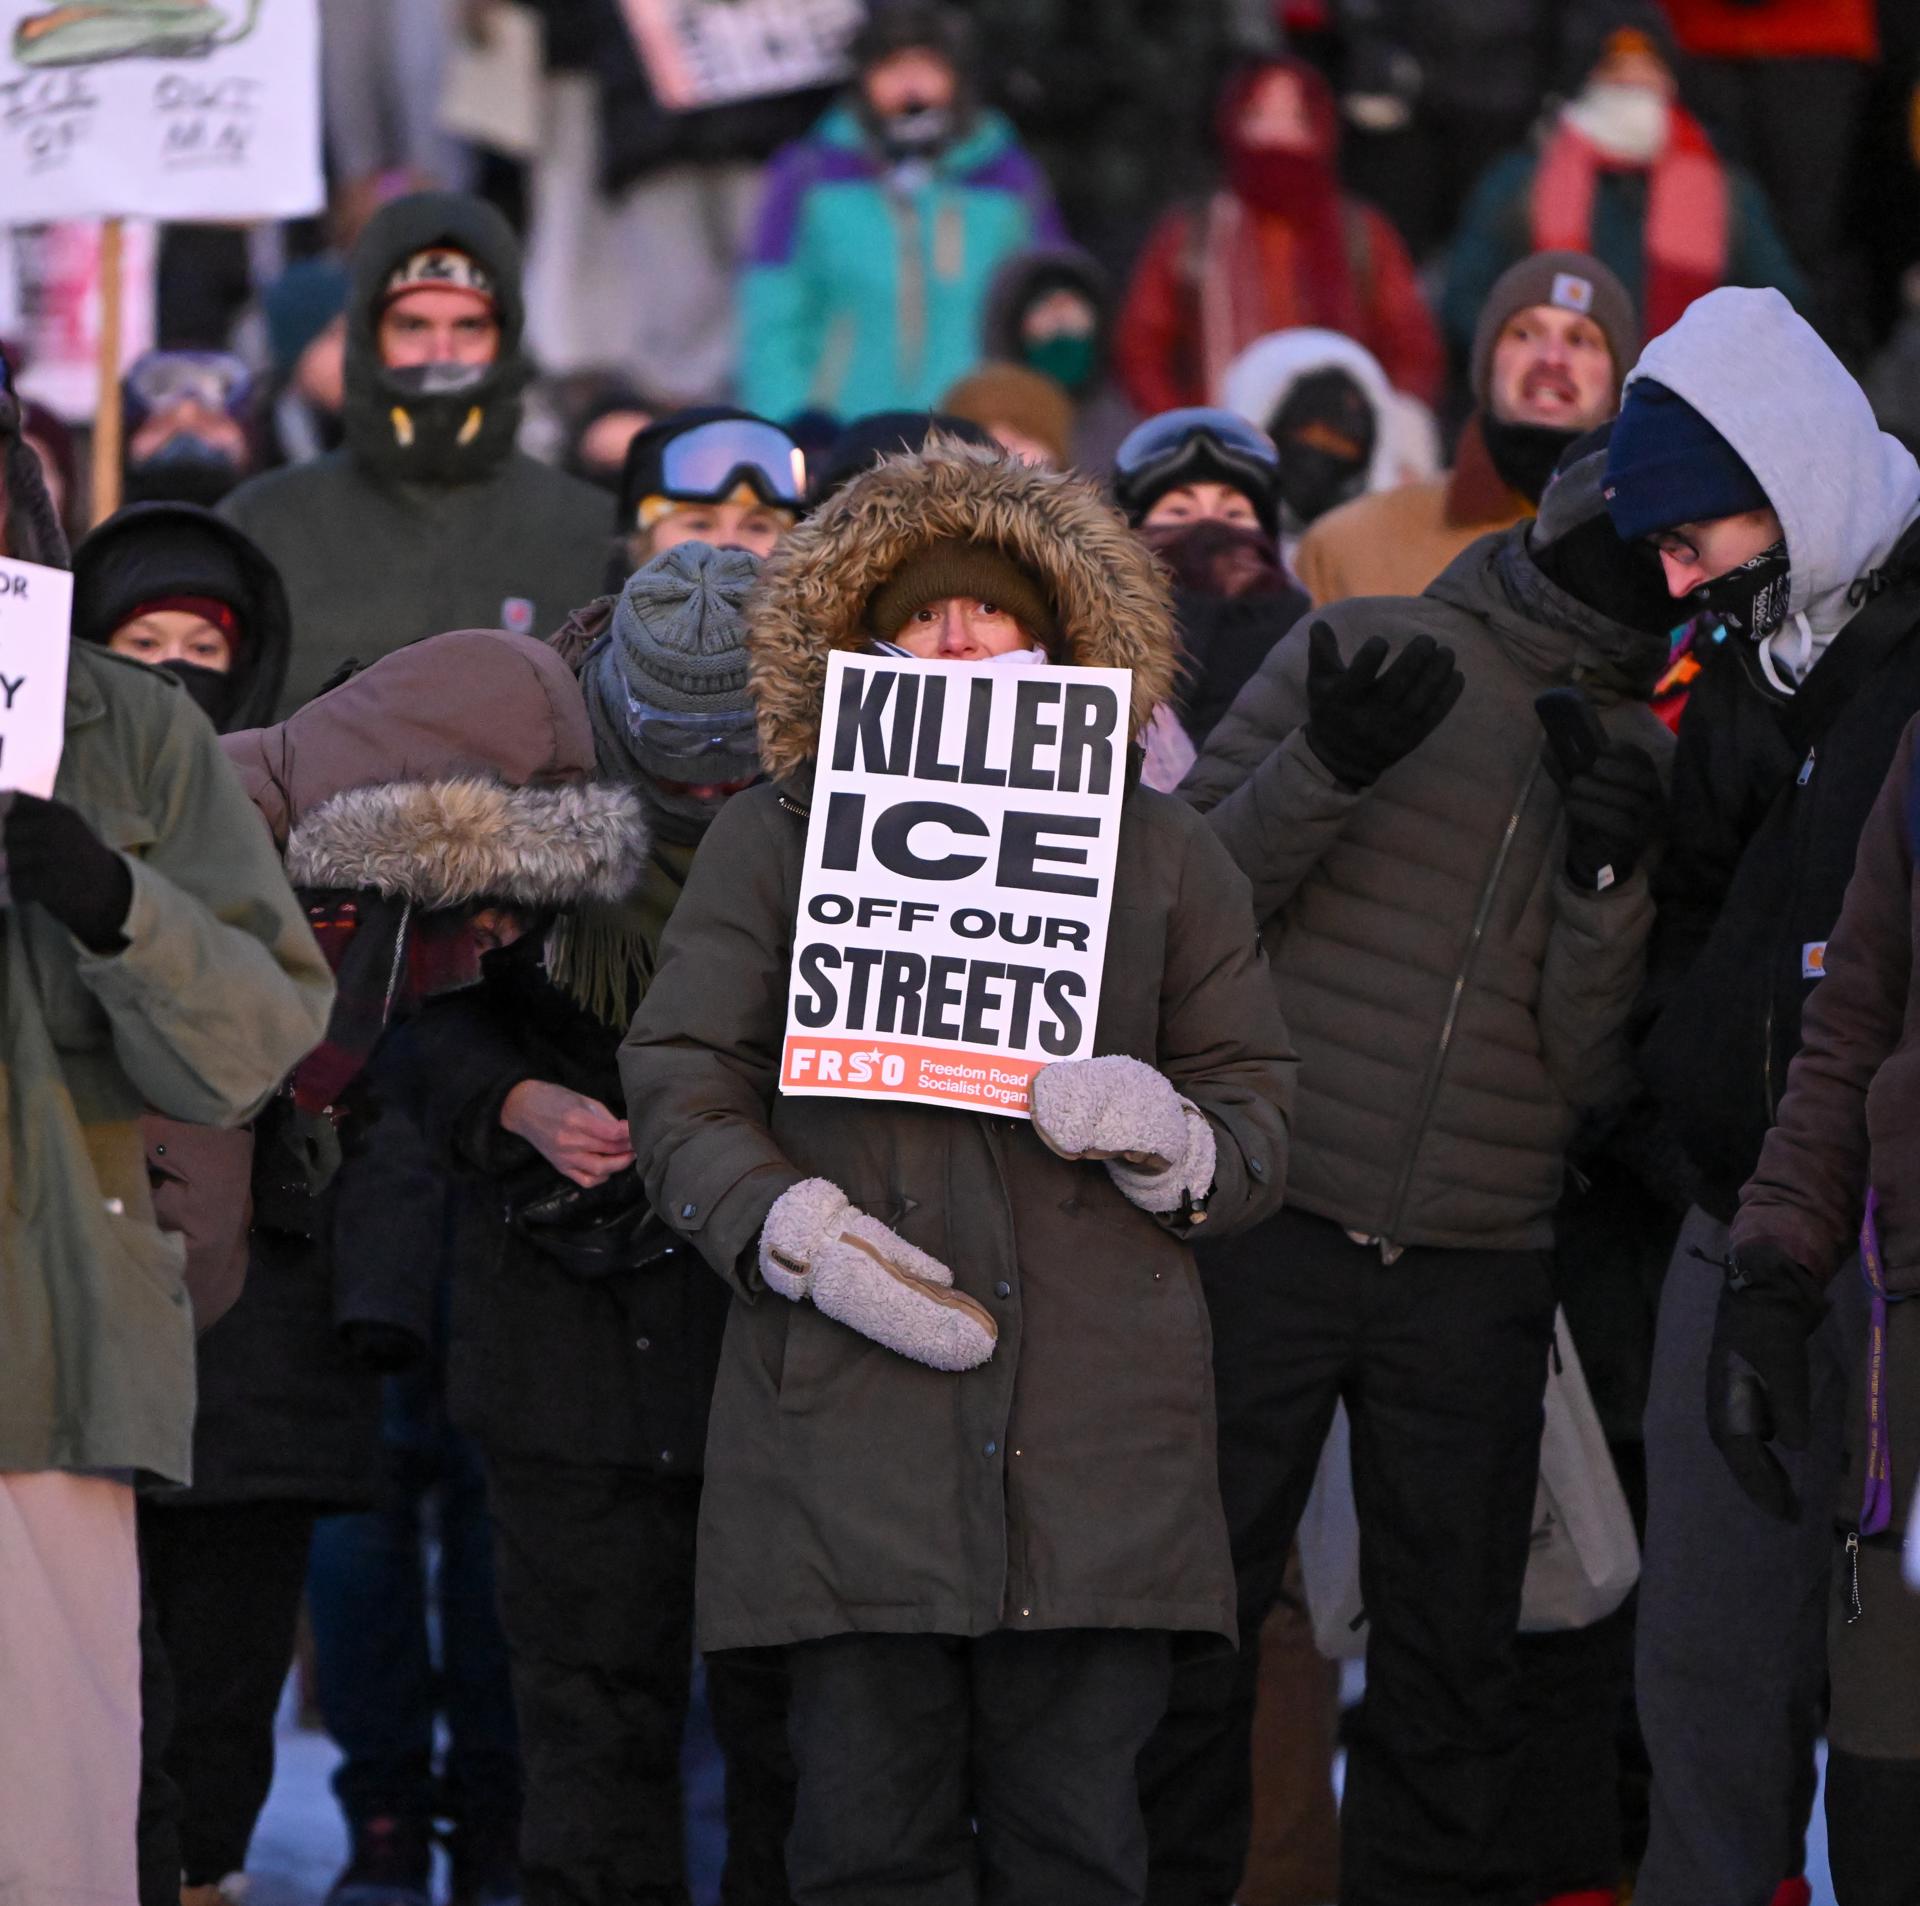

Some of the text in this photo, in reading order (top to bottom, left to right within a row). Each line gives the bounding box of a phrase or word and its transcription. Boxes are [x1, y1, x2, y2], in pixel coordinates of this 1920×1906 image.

[831, 666, 1118, 795] KILLER
[821, 792, 1101, 898] ICE
[807, 893, 1091, 952] OFF OUR
[794, 942, 1087, 1056] STREETS
[790, 1048, 905, 1086] FRSO
[918, 1075, 981, 1096] Socialist
[920, 1059, 1029, 1087] Freedom Road
